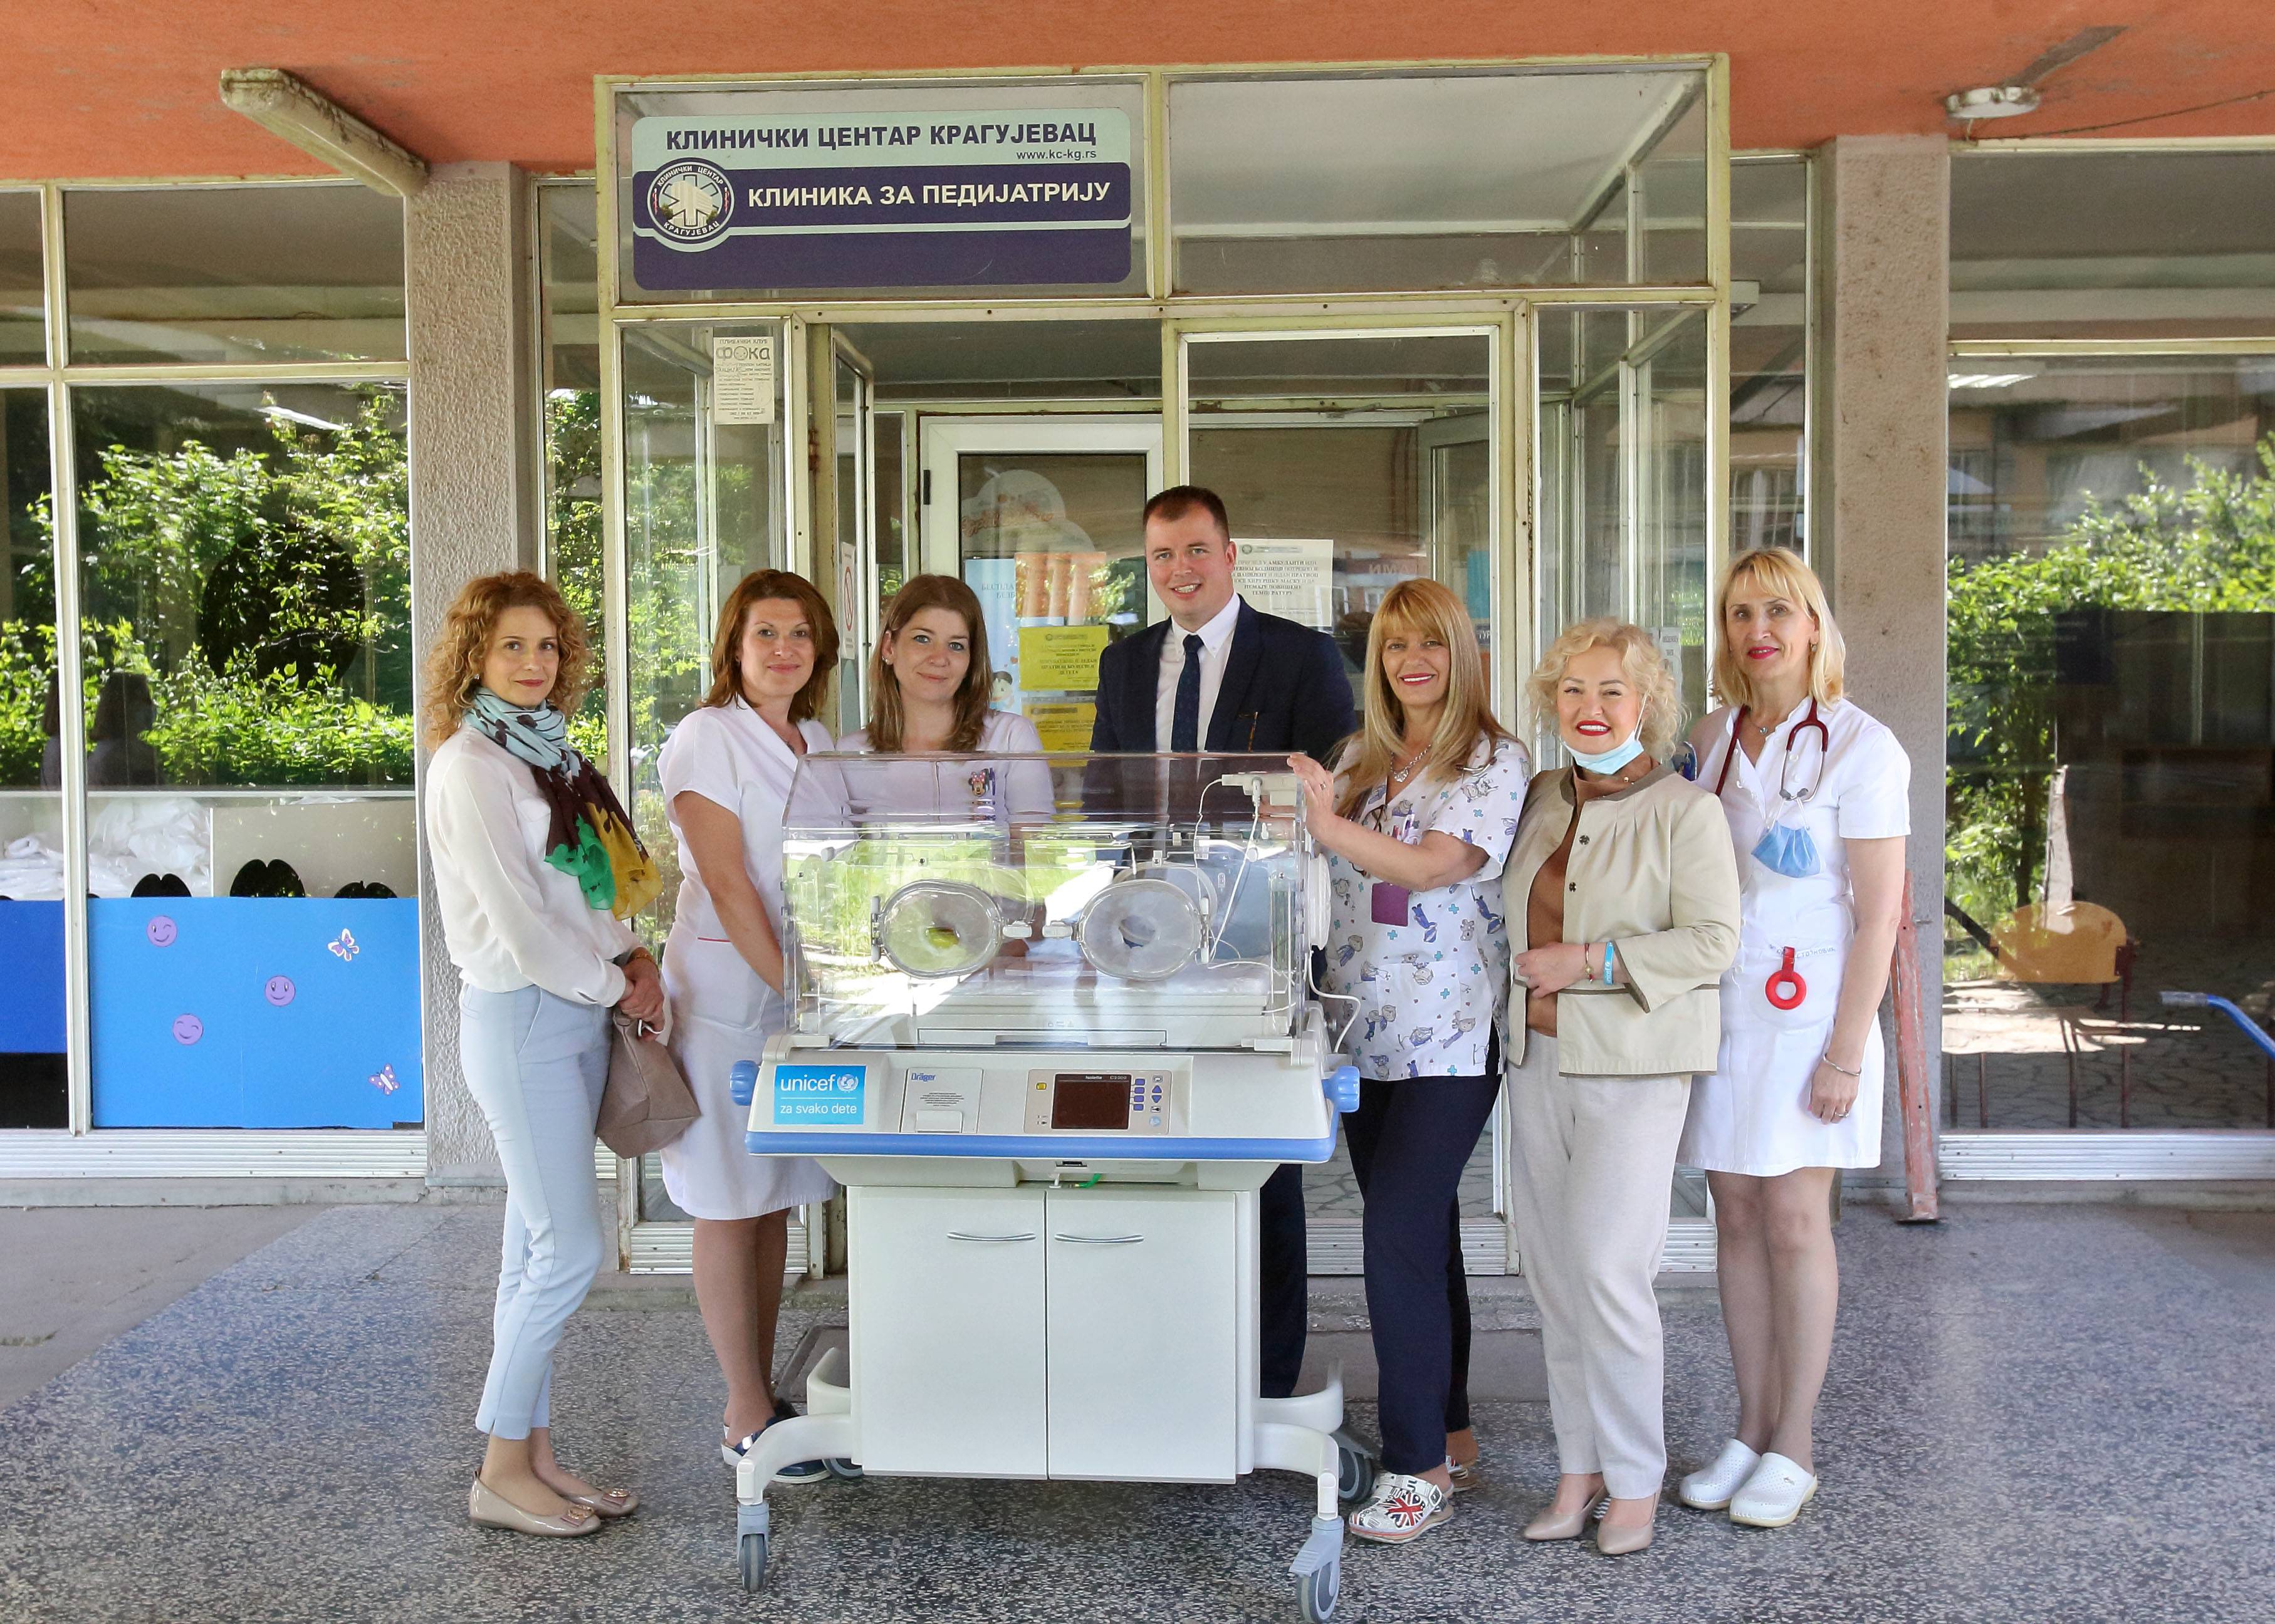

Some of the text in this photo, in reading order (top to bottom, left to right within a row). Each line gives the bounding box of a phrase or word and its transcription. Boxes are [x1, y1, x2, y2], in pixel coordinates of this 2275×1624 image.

[666, 122, 1097, 150] КЛИНИЧКИ ЦЕНТАР КРАГУЈЕВАЦ
[1016, 148, 1097, 160] www.kc-kg.rs
[657, 165, 724, 187] КЛИНИЧКИ ЦЕНТАР
[748, 182, 1110, 207] КЛИНИКА ЗА ПЕДИЈАТРИЈУ
[663, 220, 721, 236] КРАГУЈЕВАЦ
[780, 1074, 836, 1091] unicef
[911, 1072, 936, 1082] Dräger
[780, 1103, 857, 1114] za svako dete
